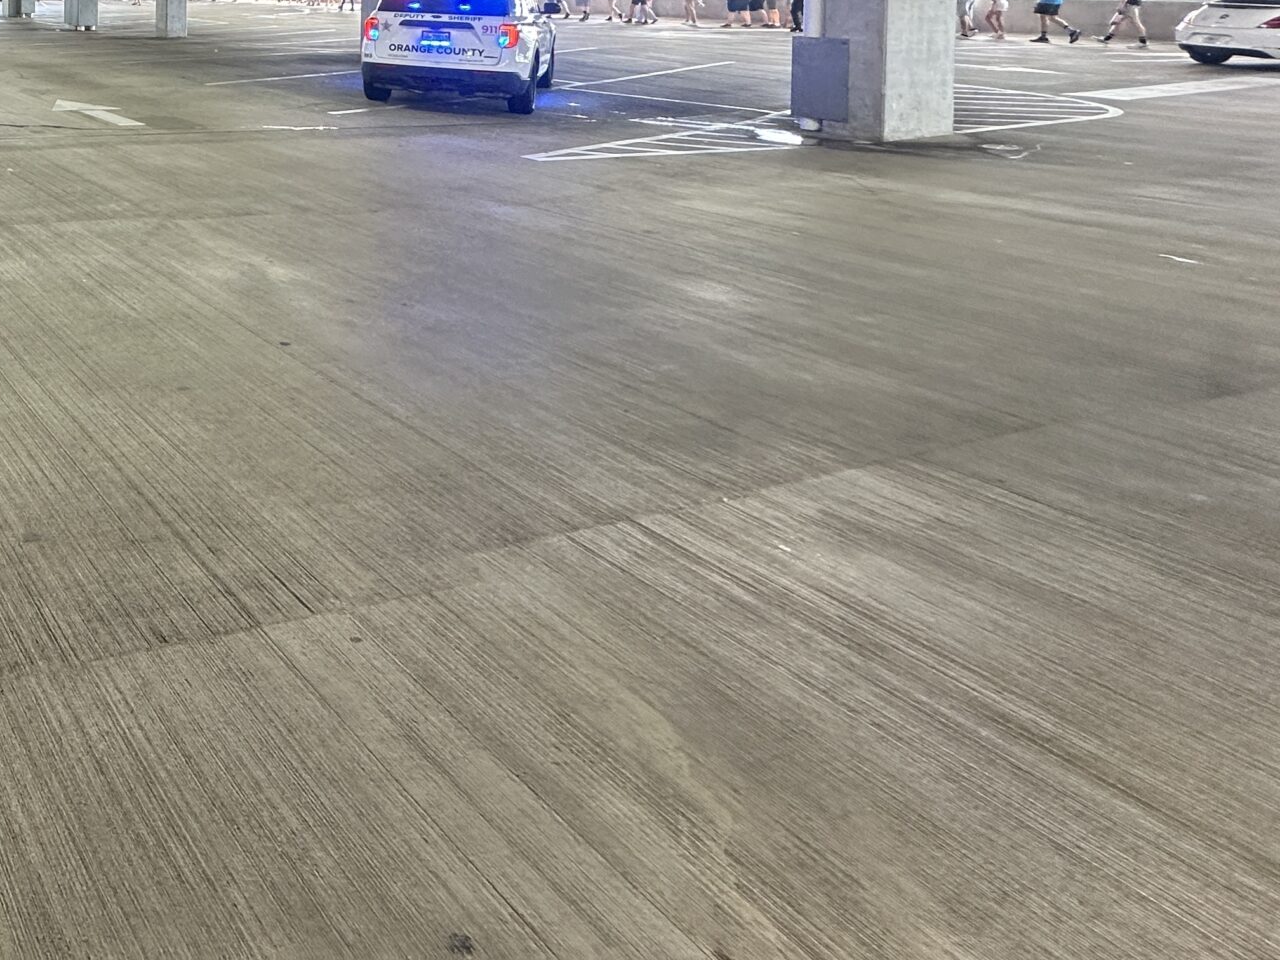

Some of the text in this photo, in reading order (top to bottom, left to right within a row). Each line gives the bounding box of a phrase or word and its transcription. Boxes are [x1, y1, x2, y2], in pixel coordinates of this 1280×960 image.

[481, 25, 498, 34] 911
[388, 43, 485, 57] ORANGE COUNTY
